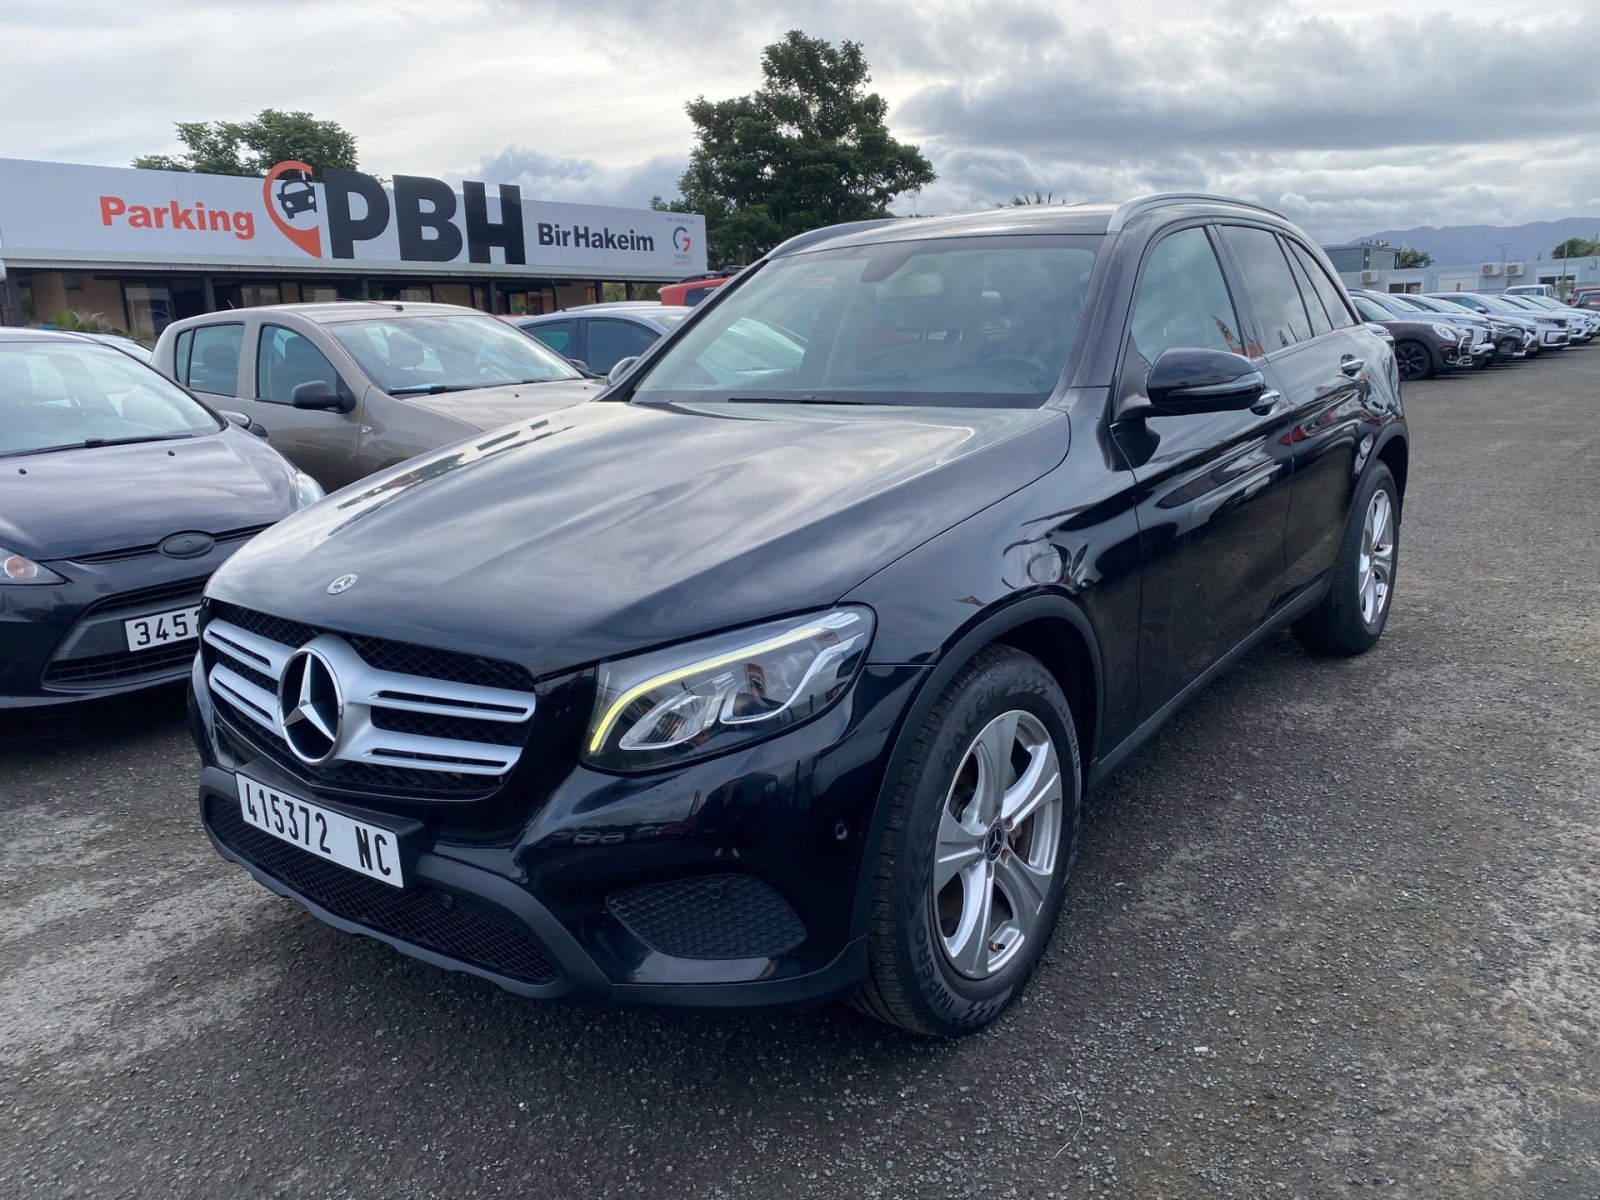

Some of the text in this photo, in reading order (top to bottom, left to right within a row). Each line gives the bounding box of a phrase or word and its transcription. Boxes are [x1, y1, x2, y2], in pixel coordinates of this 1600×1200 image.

[99, 195, 255, 240] Parking
[322, 167, 527, 265] PBH
[573, 225, 654, 252] Hakeim
[245, 783, 392, 877] 415372 NC
